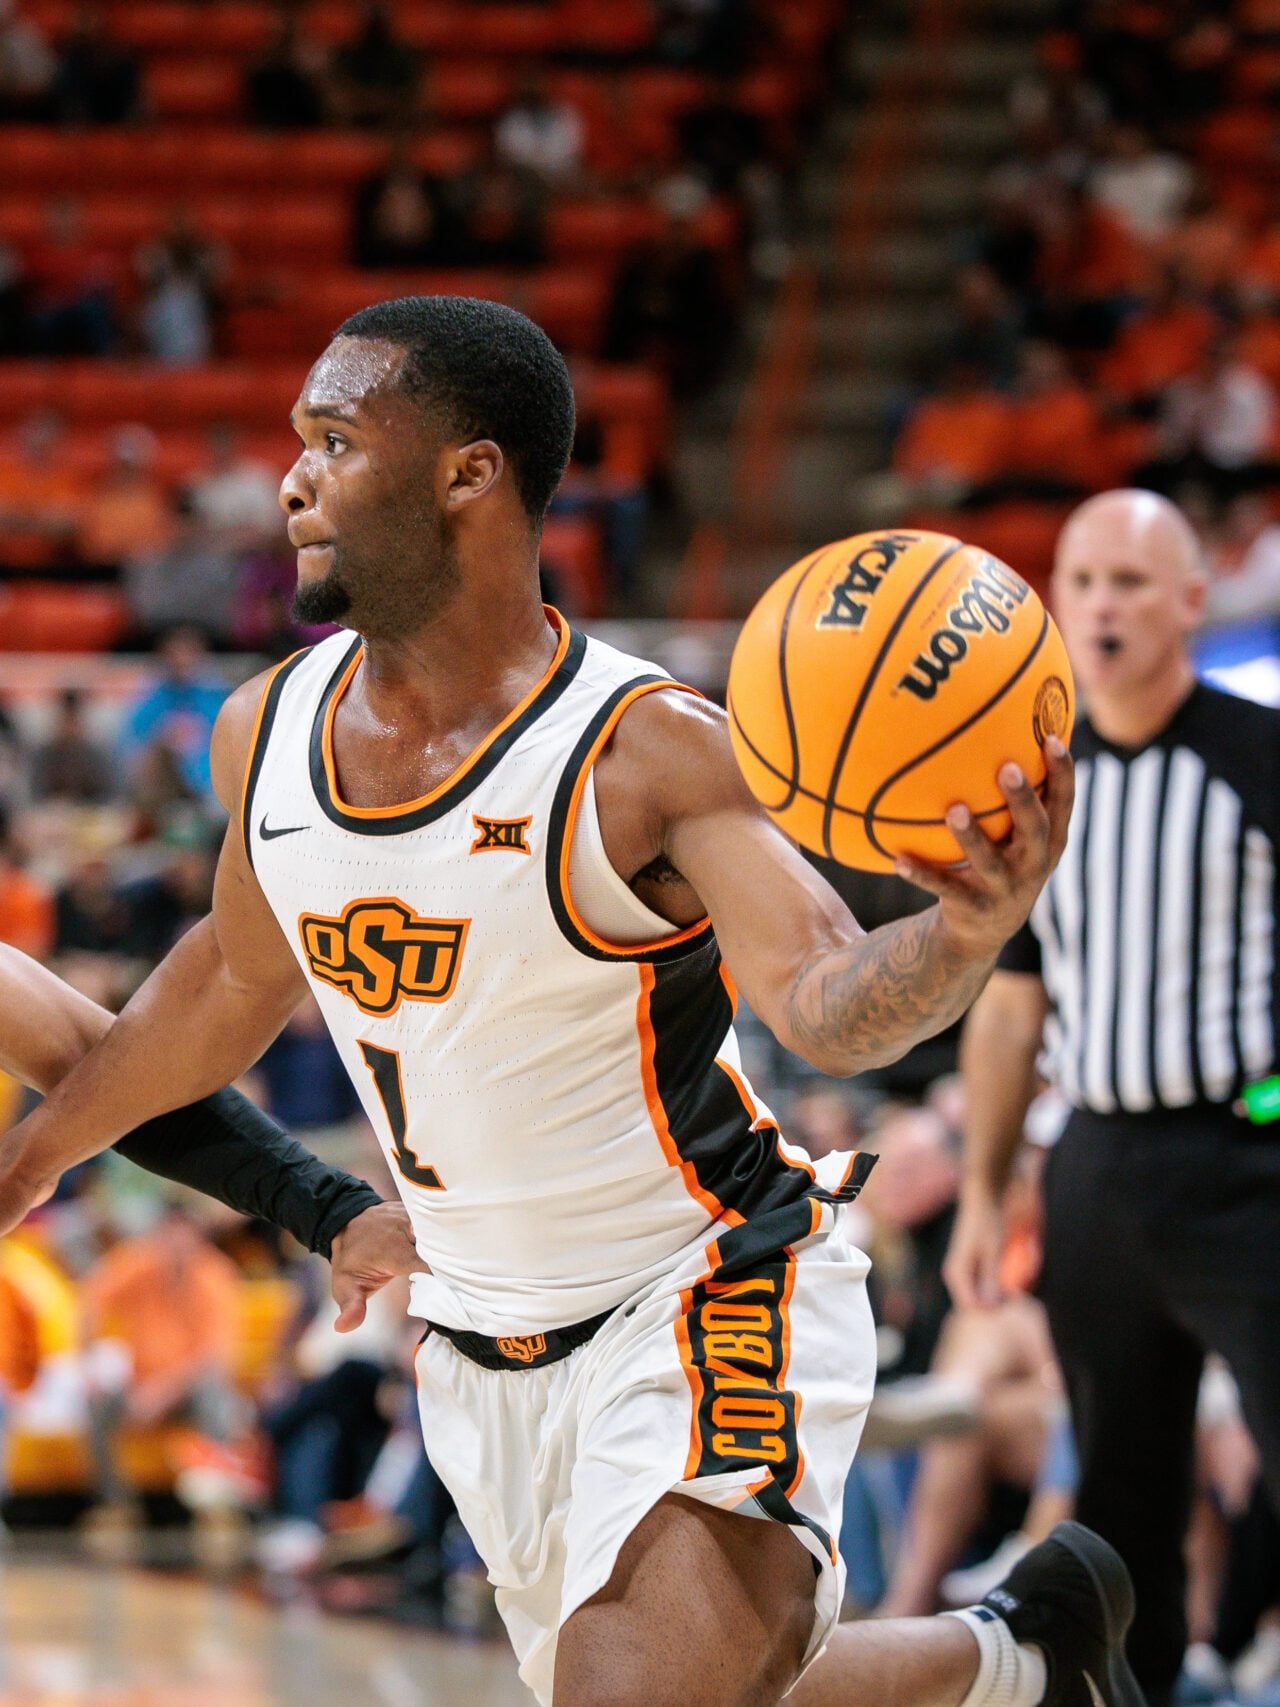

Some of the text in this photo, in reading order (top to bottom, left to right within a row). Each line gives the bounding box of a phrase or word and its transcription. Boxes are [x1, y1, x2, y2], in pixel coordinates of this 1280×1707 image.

[818, 533, 920, 628] NCAA
[896, 556, 1030, 701] Wilson
[472, 816, 530, 853] XII
[299, 898, 470, 1017] OSU
[355, 1039, 447, 1191] 1
[496, 1333, 547, 1363] OSU
